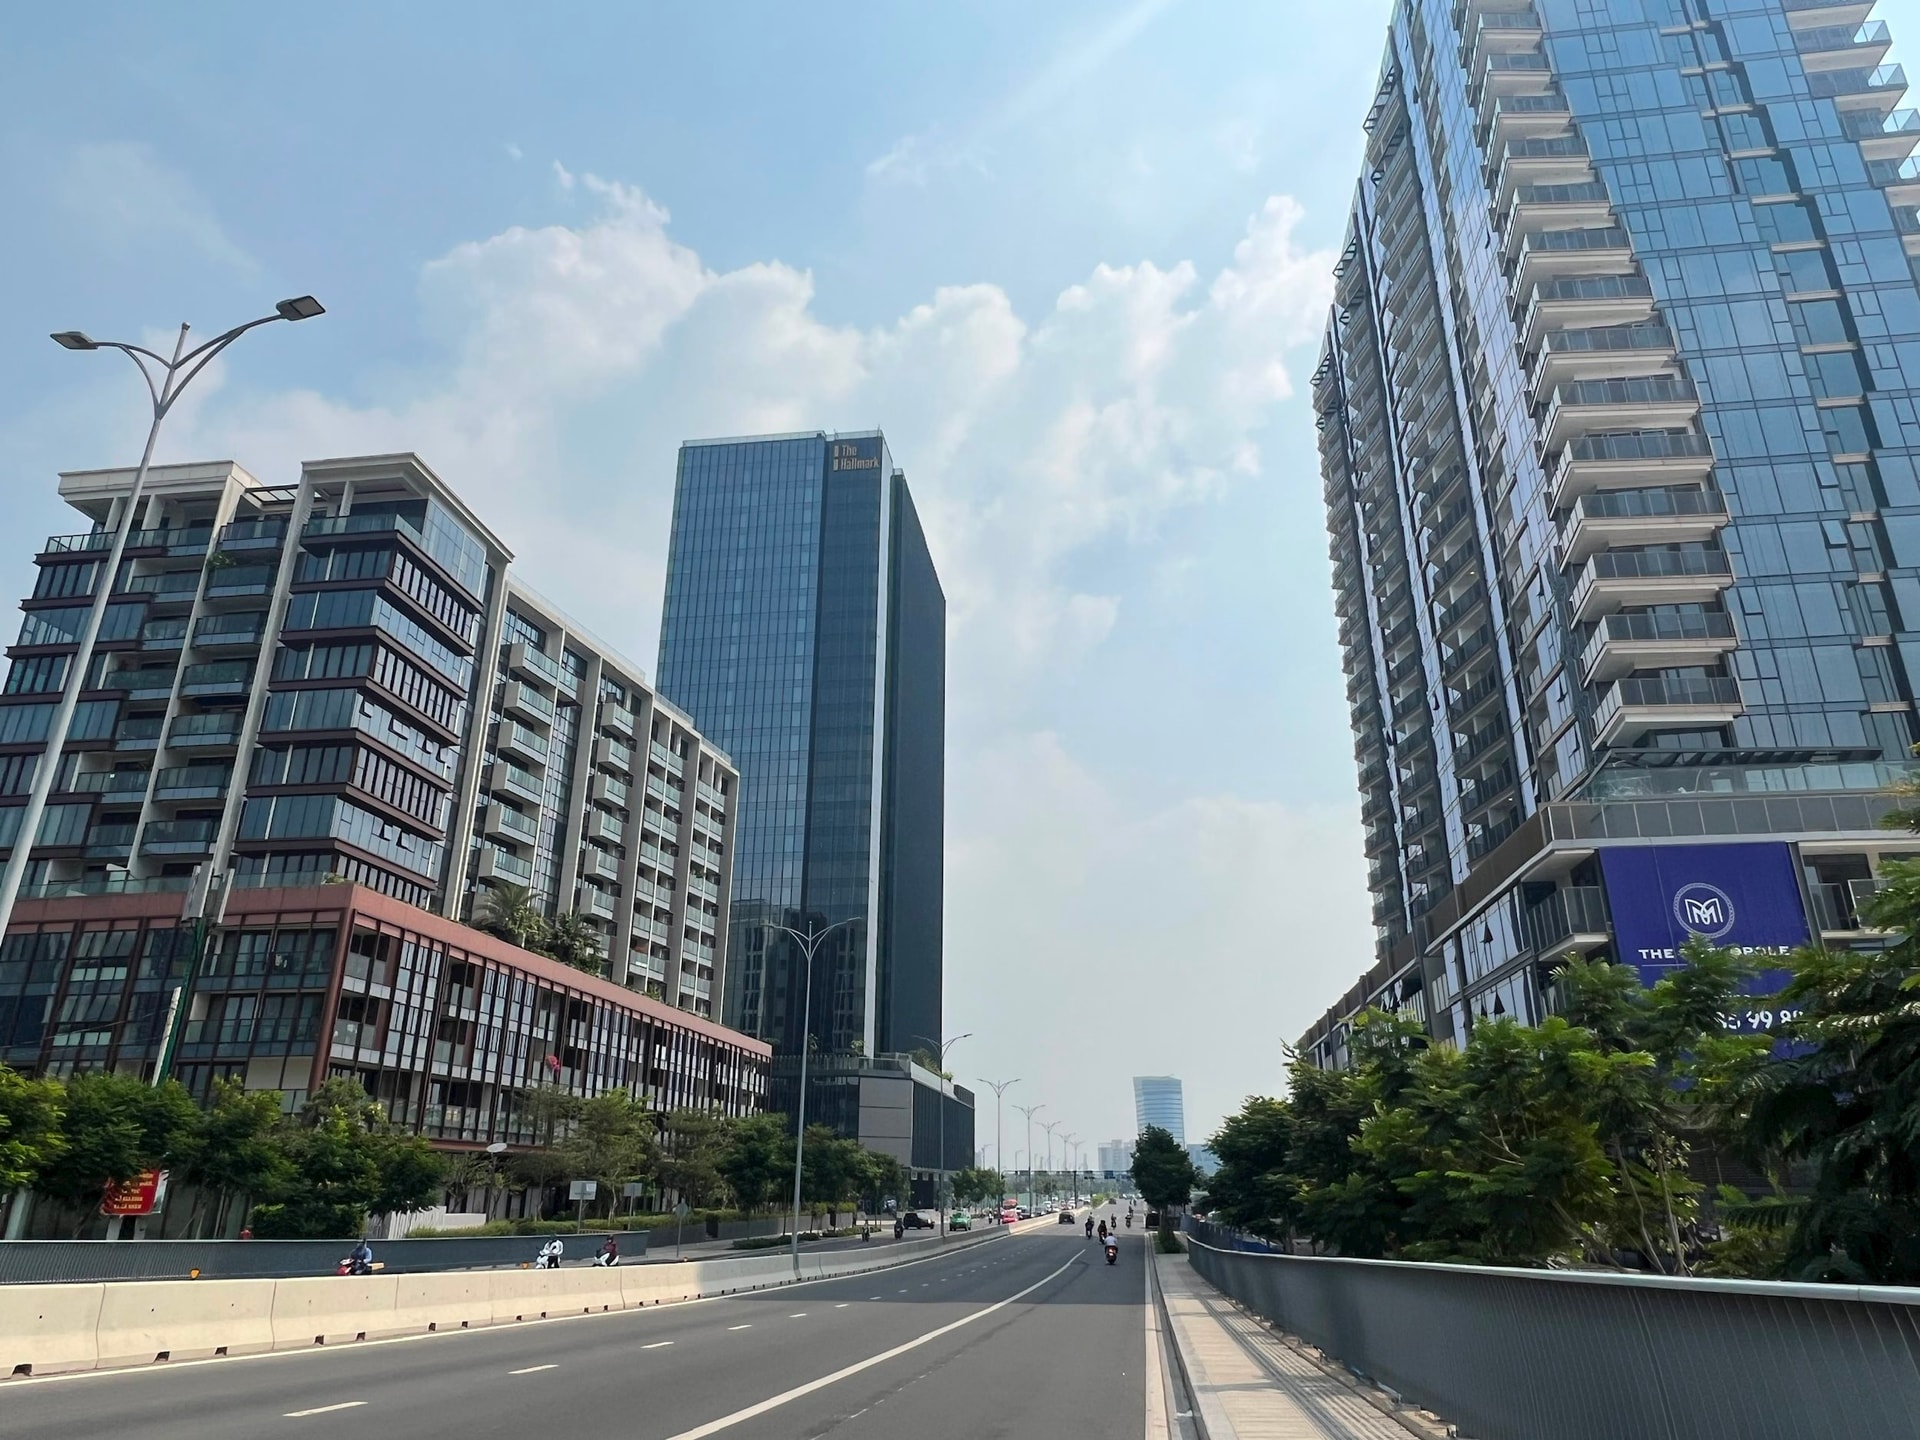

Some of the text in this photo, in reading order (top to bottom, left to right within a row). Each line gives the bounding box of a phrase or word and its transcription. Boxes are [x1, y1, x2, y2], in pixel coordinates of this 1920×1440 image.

[842, 445, 857, 457] The
[841, 457, 879, 471] Hallmark
[1638, 948, 1675, 960] THE
[1746, 1009, 1773, 1029] 99
